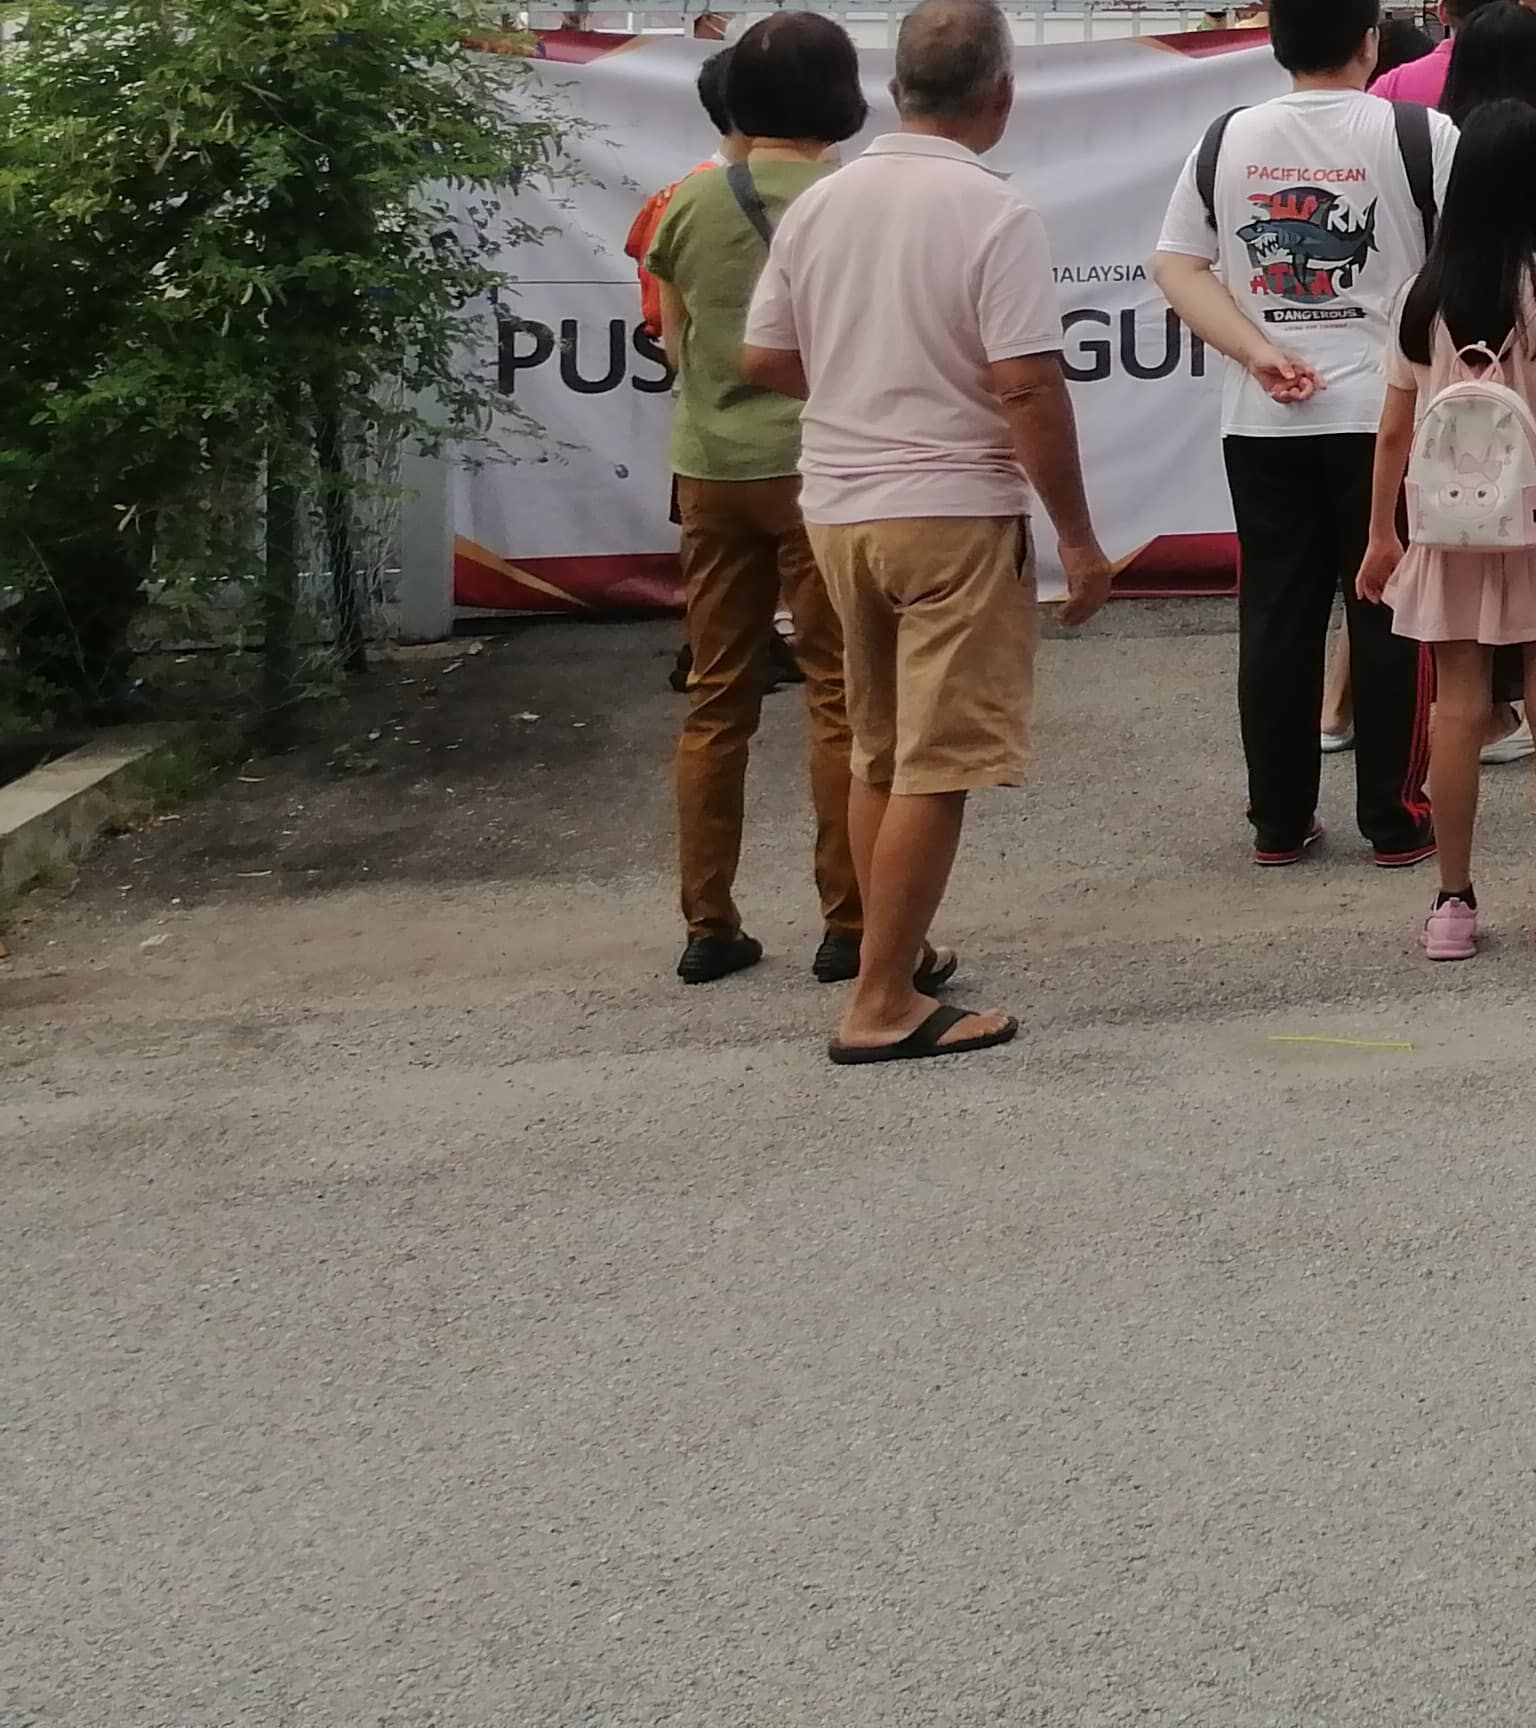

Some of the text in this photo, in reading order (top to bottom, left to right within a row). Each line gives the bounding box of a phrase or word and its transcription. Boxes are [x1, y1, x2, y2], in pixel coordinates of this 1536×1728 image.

[1246, 164, 1366, 183] PACIFIC OCEAN
[1273, 308, 1357, 322] DANGEROUS
